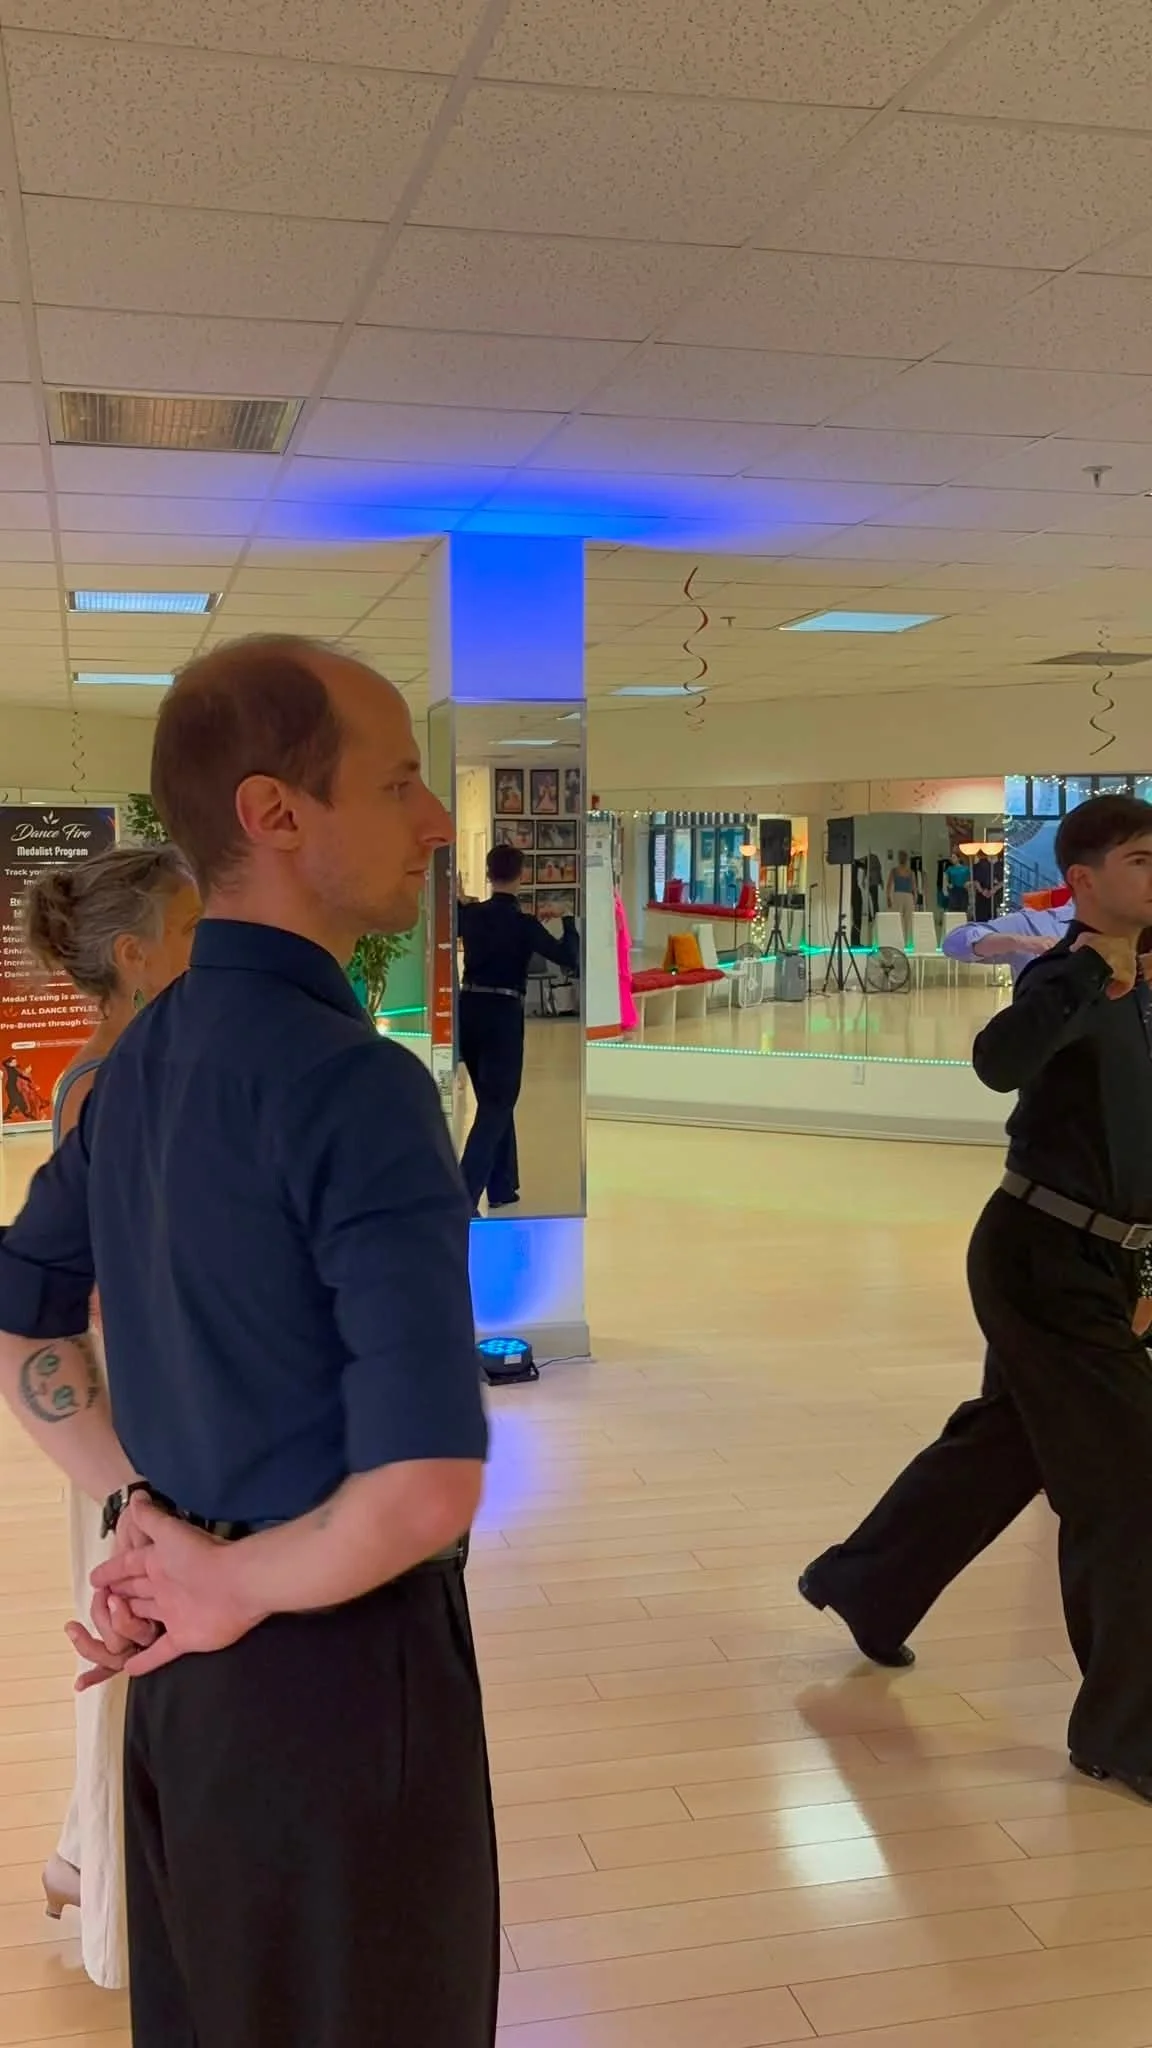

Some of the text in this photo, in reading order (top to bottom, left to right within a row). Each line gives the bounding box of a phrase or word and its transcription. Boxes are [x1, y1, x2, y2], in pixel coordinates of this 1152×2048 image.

[10, 823, 93, 842] Dance Fire
[17, 846, 89, 858] Medalist Program
[4, 868, 28, 876] Track
[2, 995, 28, 1003] Medal
[29, 993, 60, 1002] Testing
[61, 992, 69, 1001] is
[20, 1004, 98, 1016] ALL DANCE STYLES
[0, 1021, 47, 1030] Pre-Bronze
[48, 1019, 81, 1028] through
